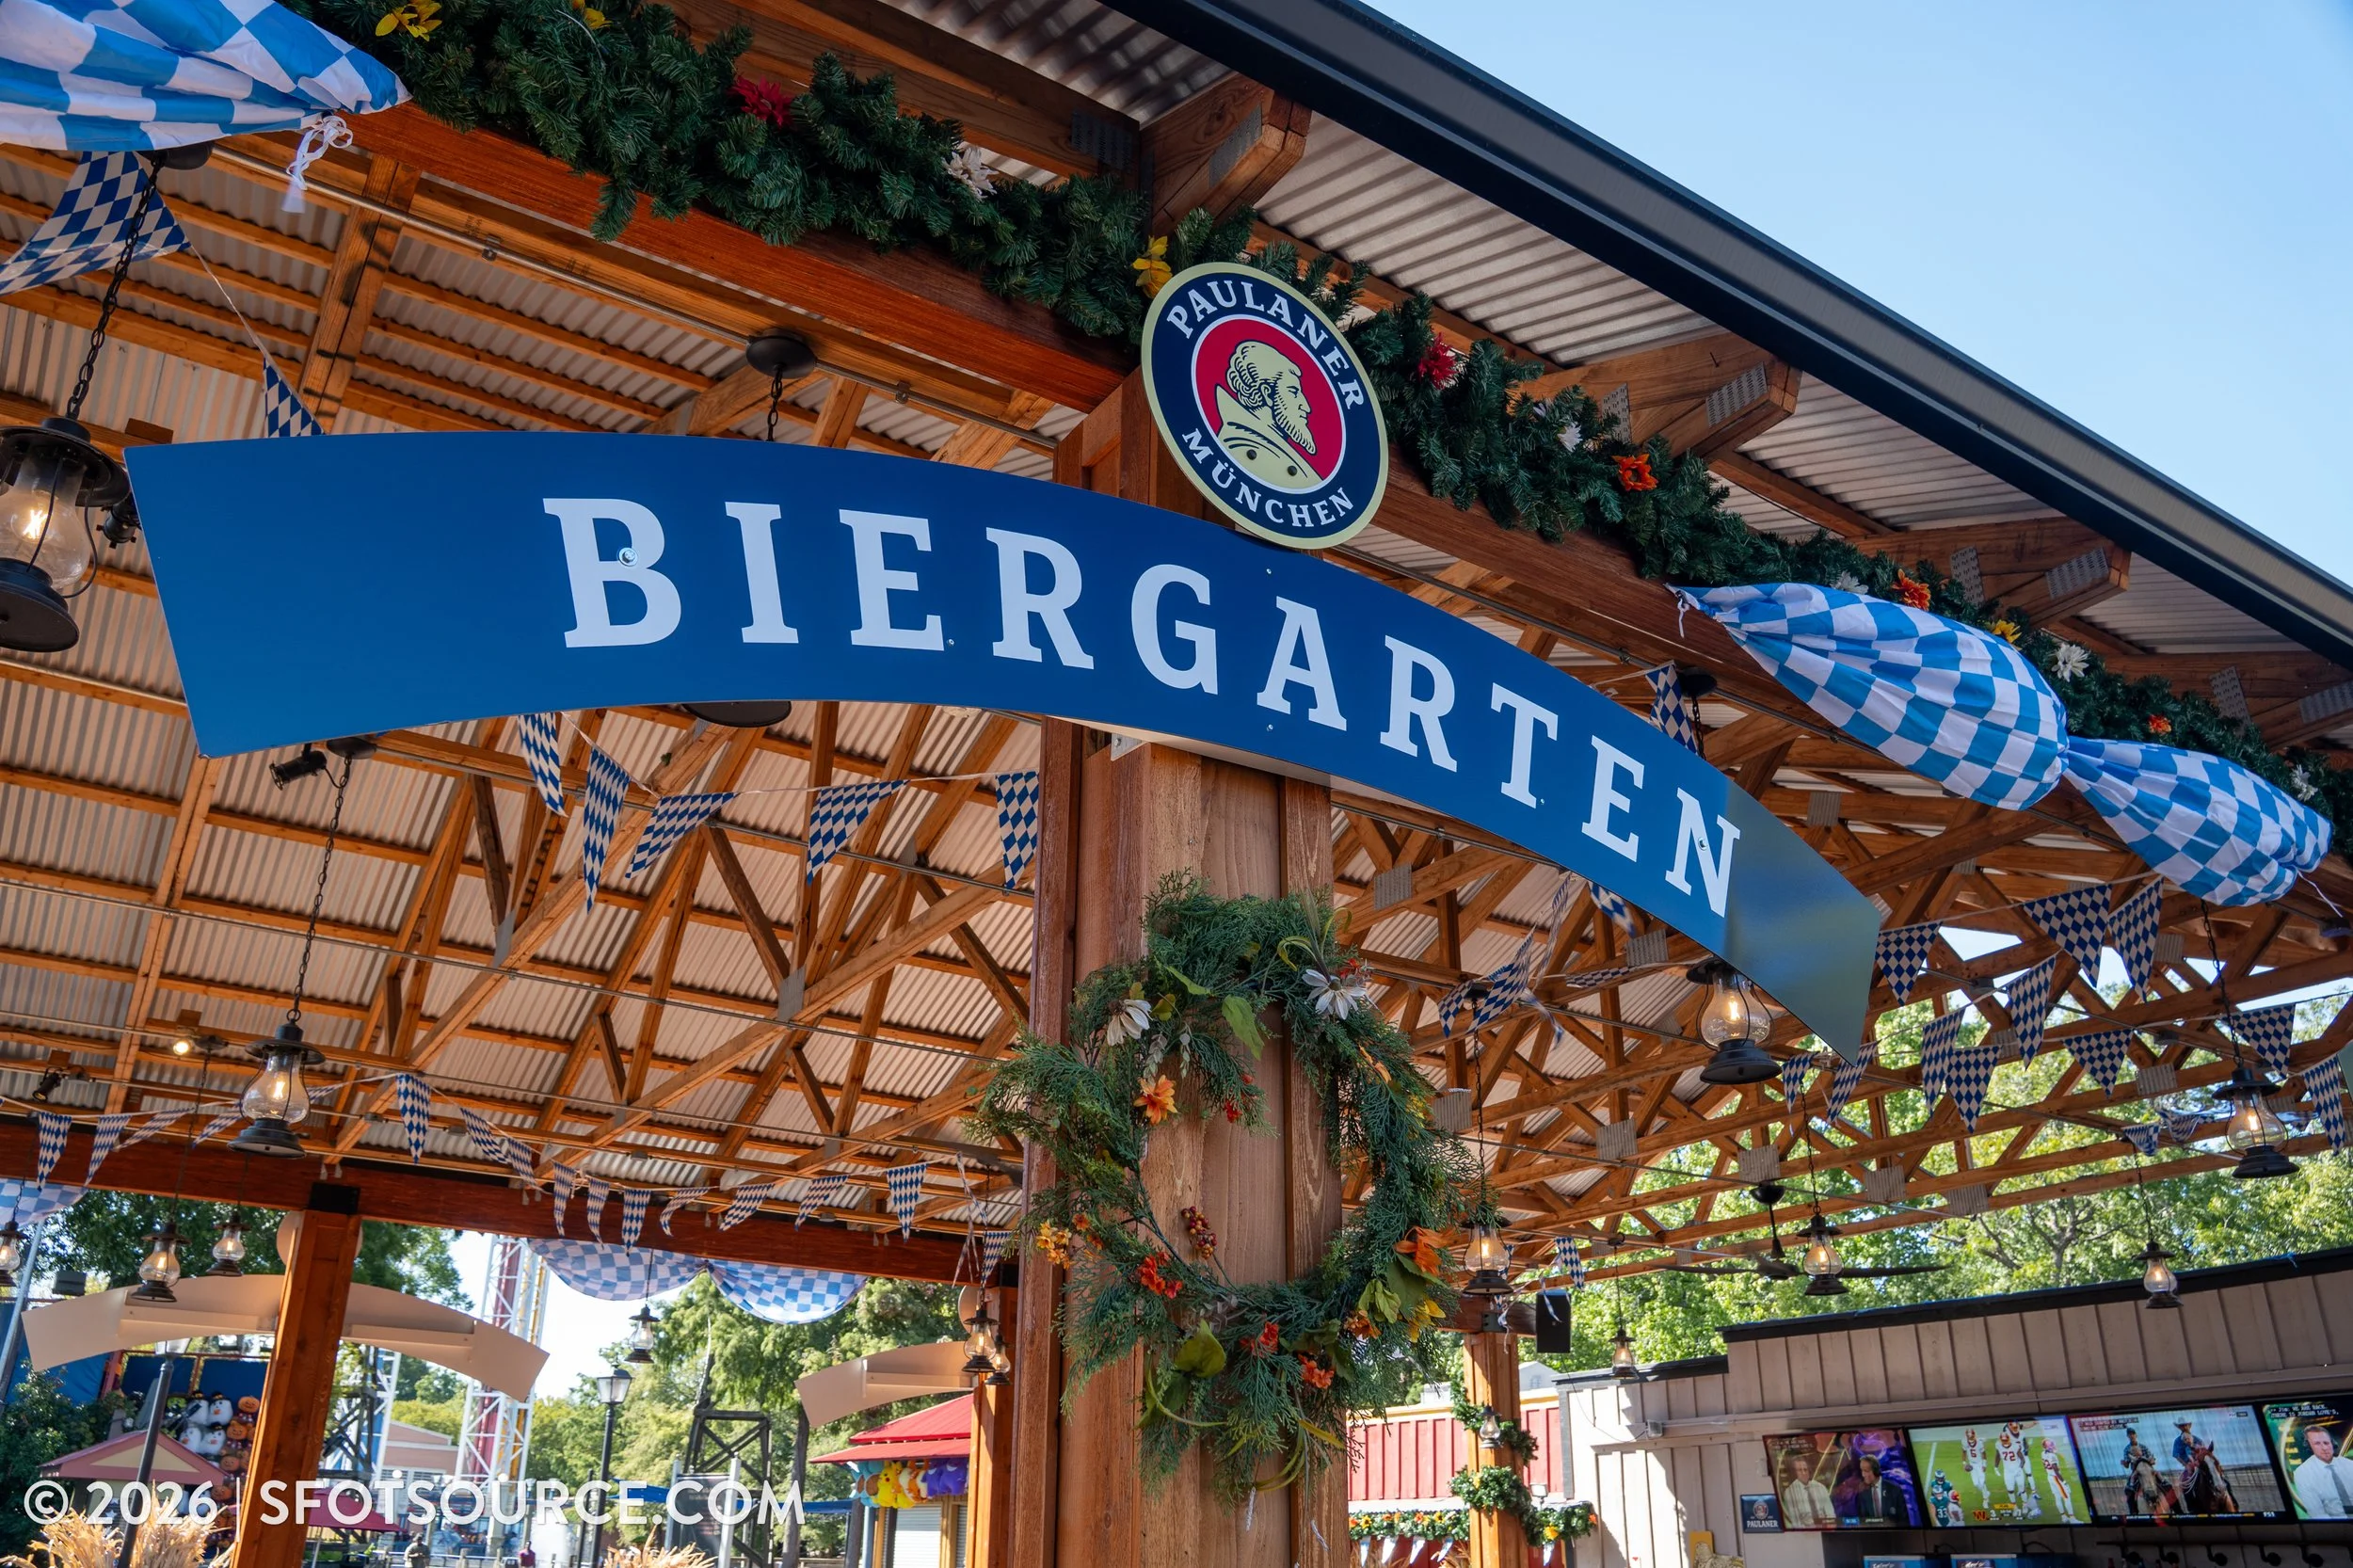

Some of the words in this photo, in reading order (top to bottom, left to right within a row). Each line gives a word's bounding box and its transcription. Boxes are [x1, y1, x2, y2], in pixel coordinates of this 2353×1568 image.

[1166, 280, 1365, 410] PAULANER
[1181, 427, 1354, 528] MÜNCHEN
[543, 498, 1741, 918] BIERGARTEN
[2001, 1450, 2016, 1462] 72
[1746, 1520, 1779, 1528] PAULANER
